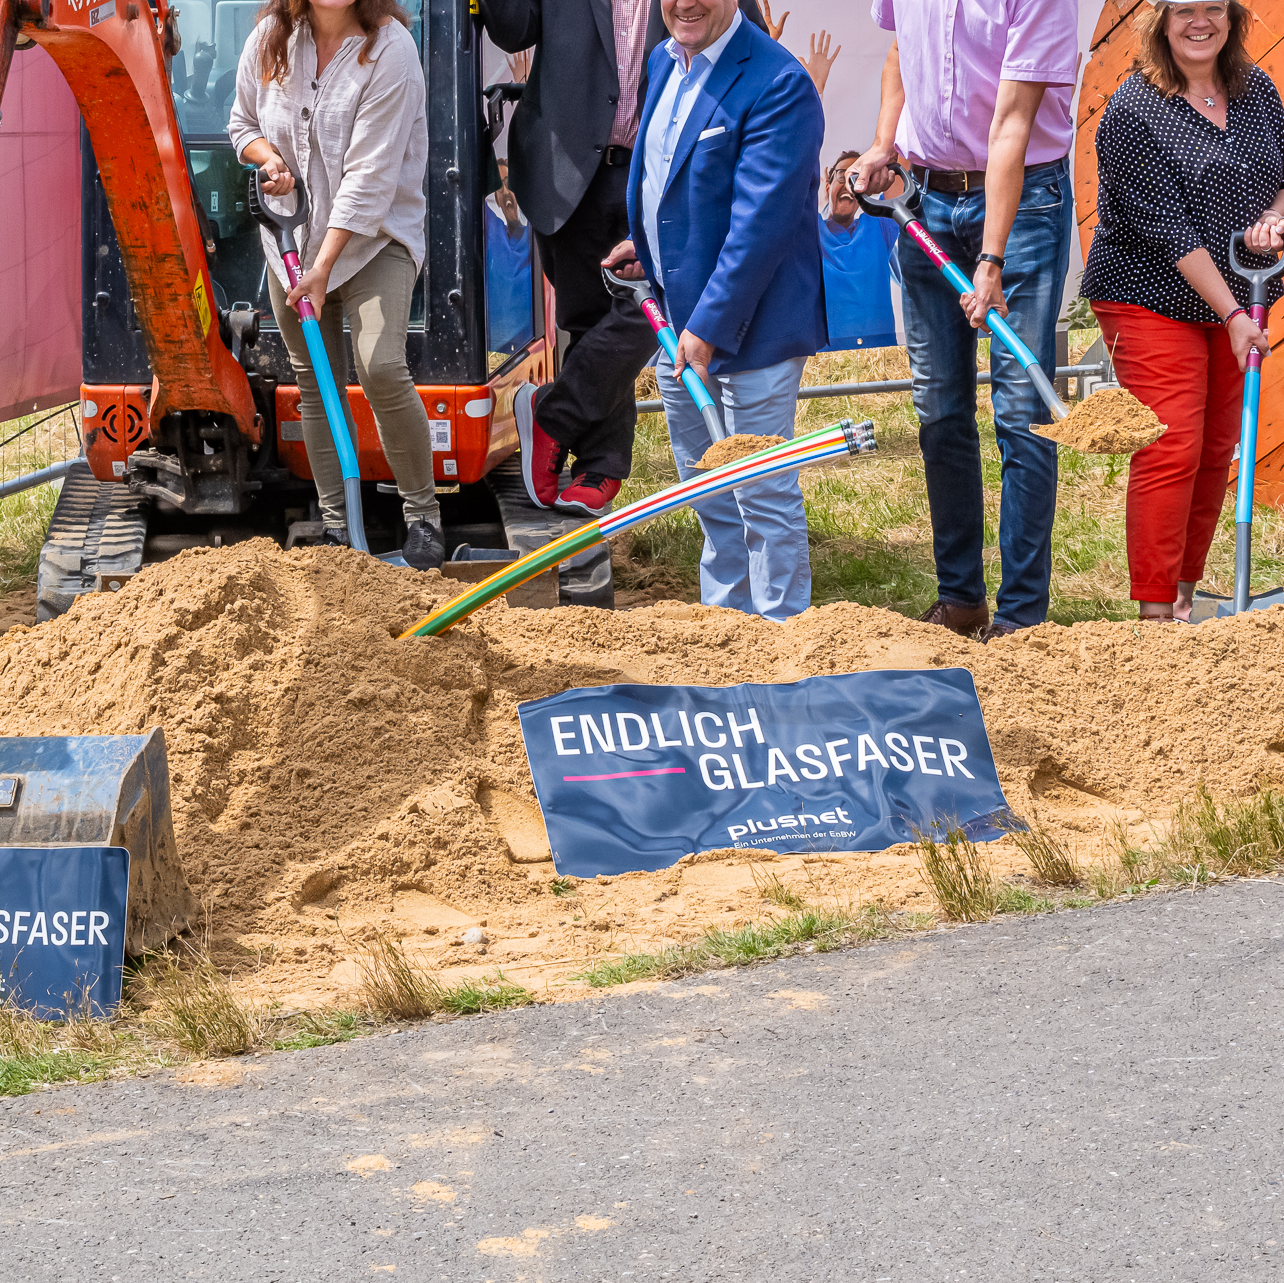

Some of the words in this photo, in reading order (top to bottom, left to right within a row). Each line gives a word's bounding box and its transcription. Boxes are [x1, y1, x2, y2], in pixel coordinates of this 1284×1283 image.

[915, 229, 943, 255] plusnet
[550, 708, 765, 756] ENDLICH
[699, 733, 975, 790] GLASFASER
[727, 807, 853, 841] plusnet
[734, 841, 749, 849] Ein
[751, 832, 811, 846] Unternehmen
[829, 830, 857, 838] EnBW
